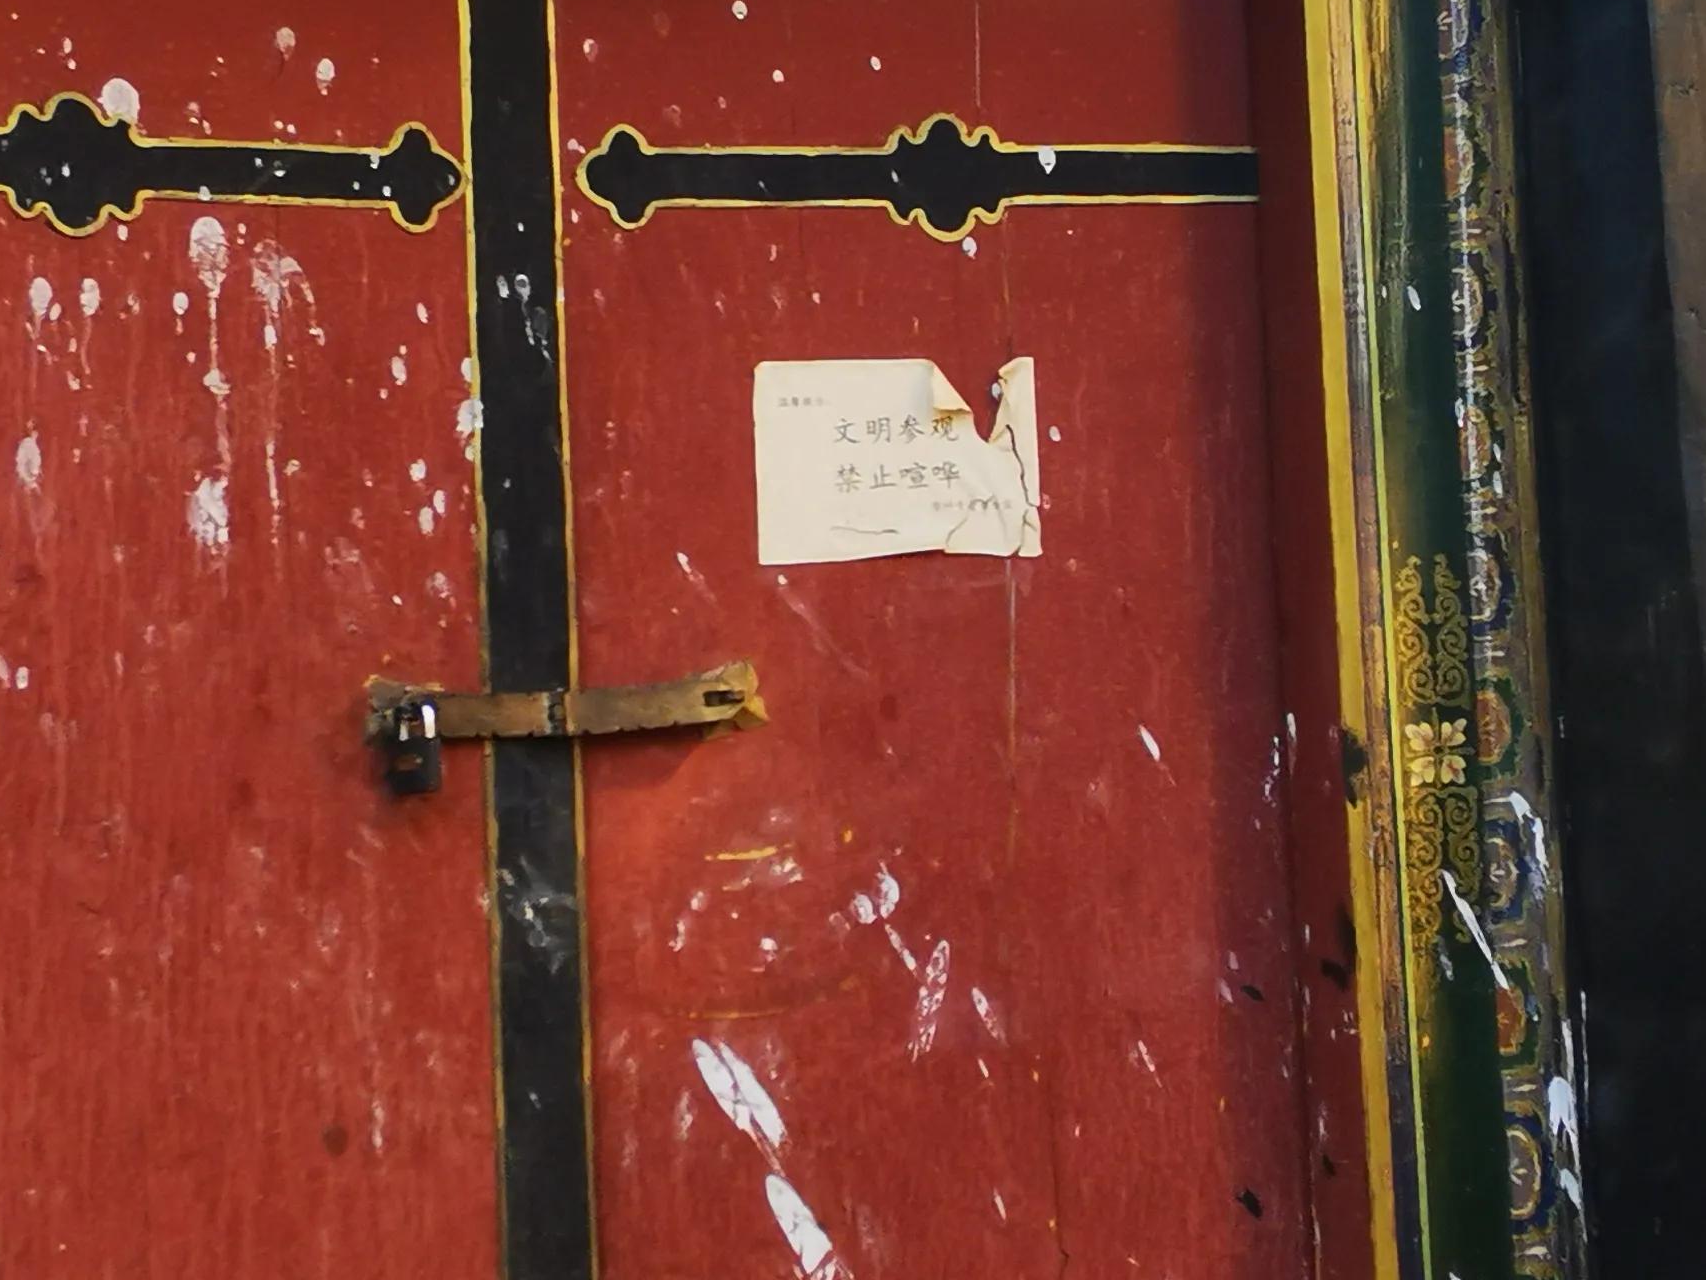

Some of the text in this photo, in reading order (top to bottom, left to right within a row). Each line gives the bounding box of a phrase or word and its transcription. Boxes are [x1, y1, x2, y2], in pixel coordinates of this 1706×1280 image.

[834, 414, 959, 443] 文明参观
[835, 461, 960, 493] 禁止喧哗
